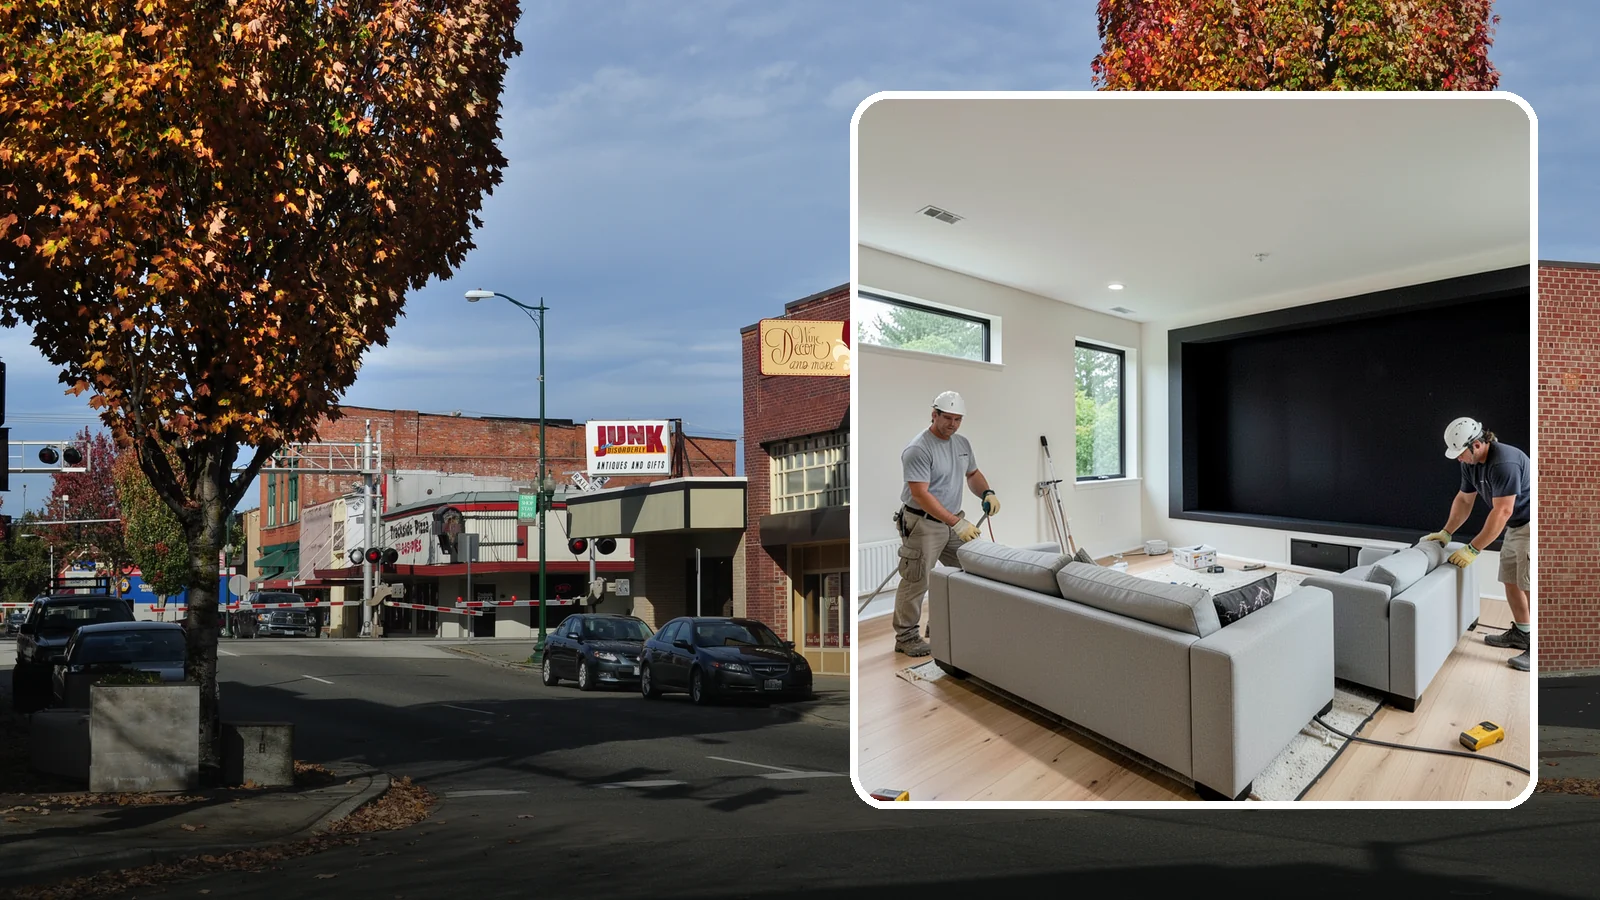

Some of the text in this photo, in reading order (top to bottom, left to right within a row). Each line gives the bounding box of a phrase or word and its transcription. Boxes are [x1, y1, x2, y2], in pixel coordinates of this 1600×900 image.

[595, 425, 665, 457] JUNK
[607, 446, 646, 454] DISORDERLY
[597, 460, 665, 470] ANTIQUES AND GIFTS
[415, 519, 429, 534] Pizza
